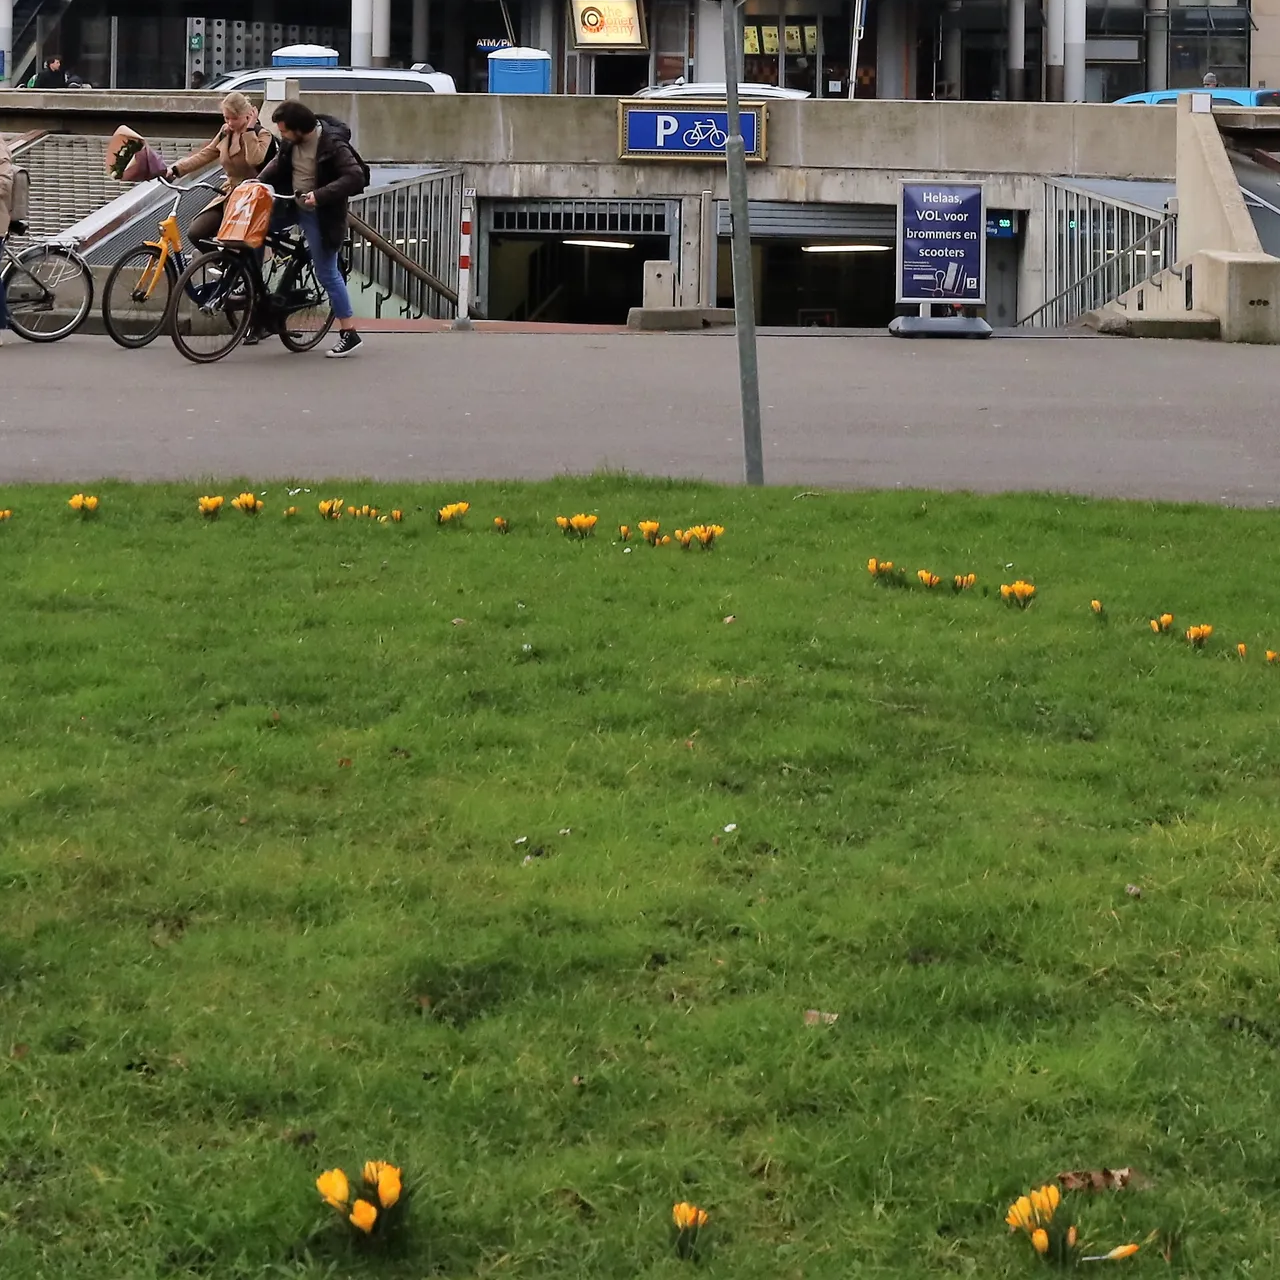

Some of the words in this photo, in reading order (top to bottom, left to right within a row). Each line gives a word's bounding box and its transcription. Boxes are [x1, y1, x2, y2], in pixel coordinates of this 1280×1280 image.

[656, 115, 679, 147] P
[923, 192, 963, 204] Helaas,
[916, 210, 941, 221] VOL
[943, 212, 969, 221] voor
[906, 228, 961, 239] brommers
[963, 231, 977, 239] en
[919, 248, 965, 258] scooters
